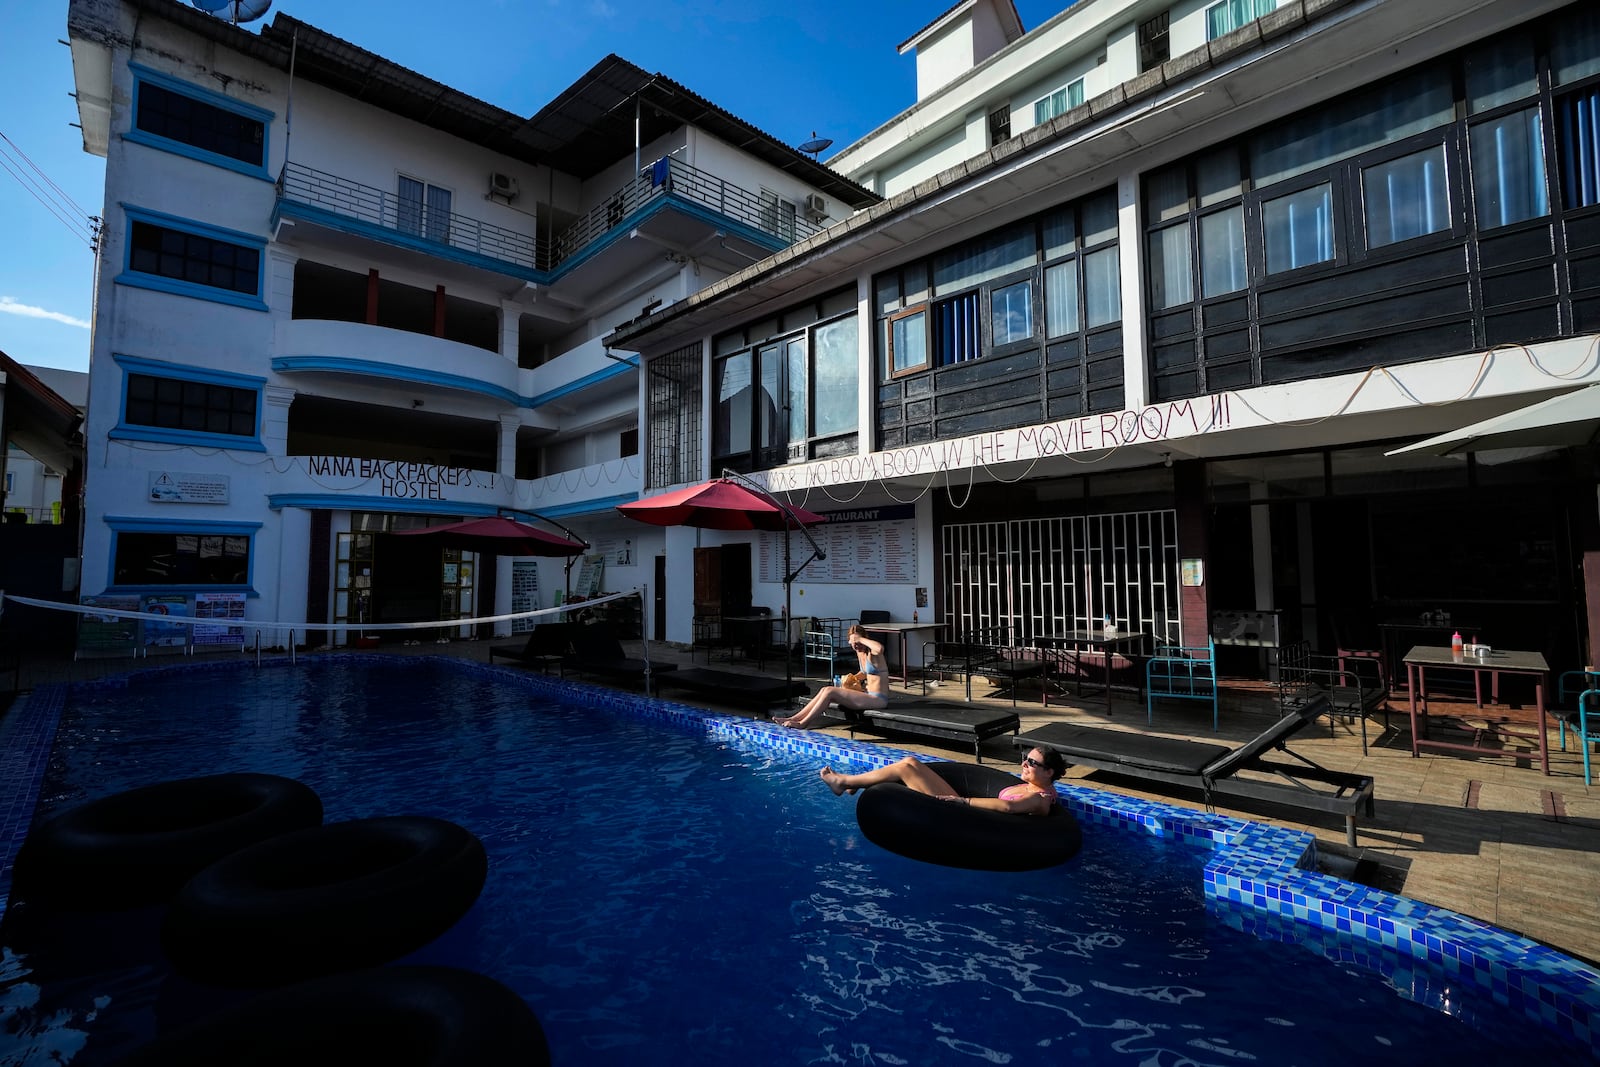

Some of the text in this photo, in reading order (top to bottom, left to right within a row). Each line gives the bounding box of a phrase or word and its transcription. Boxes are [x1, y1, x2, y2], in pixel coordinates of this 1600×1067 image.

[788, 468, 798, 489] &
[806, 463, 827, 487] NO
[831, 455, 878, 483] BOOM
[883, 445, 938, 478] BOOM
[941, 440, 964, 468] IN
[968, 432, 1006, 466] THE
[1016, 417, 1093, 460] MOVIE
[1100, 400, 1199, 448] ROOM
[1211, 393, 1231, 430] !!!
[309, 455, 355, 478] NANA
[382, 478, 447, 500] HOSTEL
[824, 509, 880, 523] STAURANT
